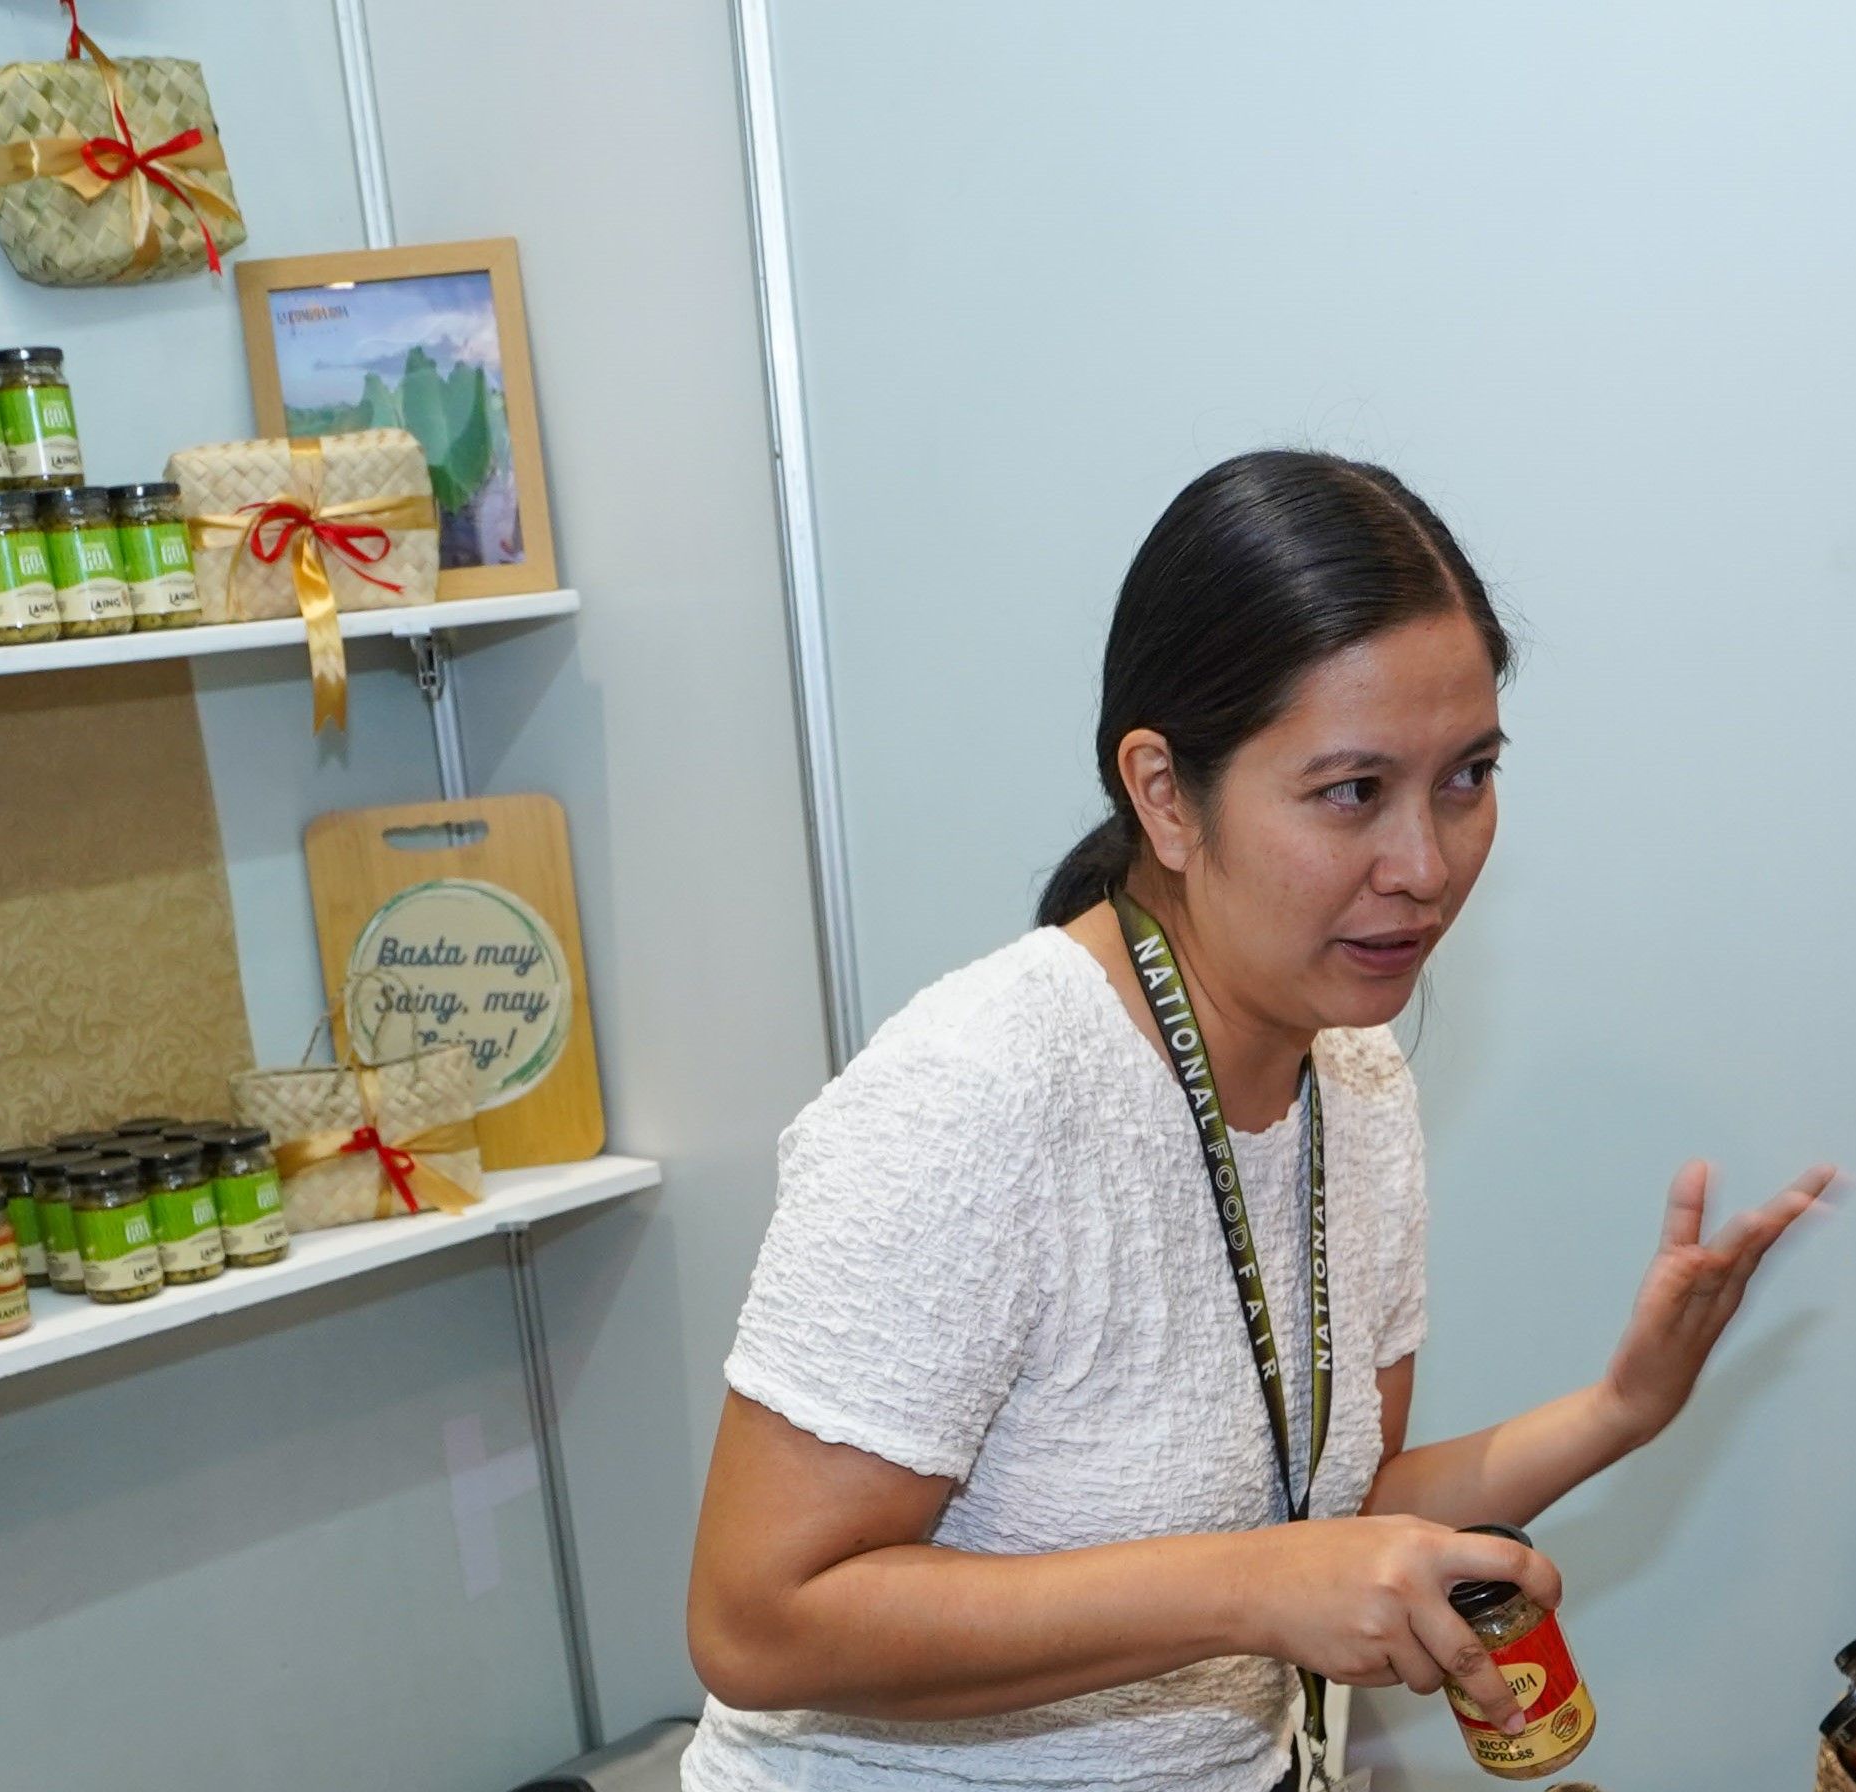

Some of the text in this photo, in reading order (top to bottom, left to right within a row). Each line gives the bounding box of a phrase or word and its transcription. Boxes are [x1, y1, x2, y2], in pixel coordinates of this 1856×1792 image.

[374, 984, 550, 1025] Saing, may
[377, 936, 544, 977] Basta may
[1134, 933, 1224, 1132] NATIONAL
[1207, 1140, 1250, 1251] FOOD
[1314, 1183, 1333, 1373] NATIONAL
